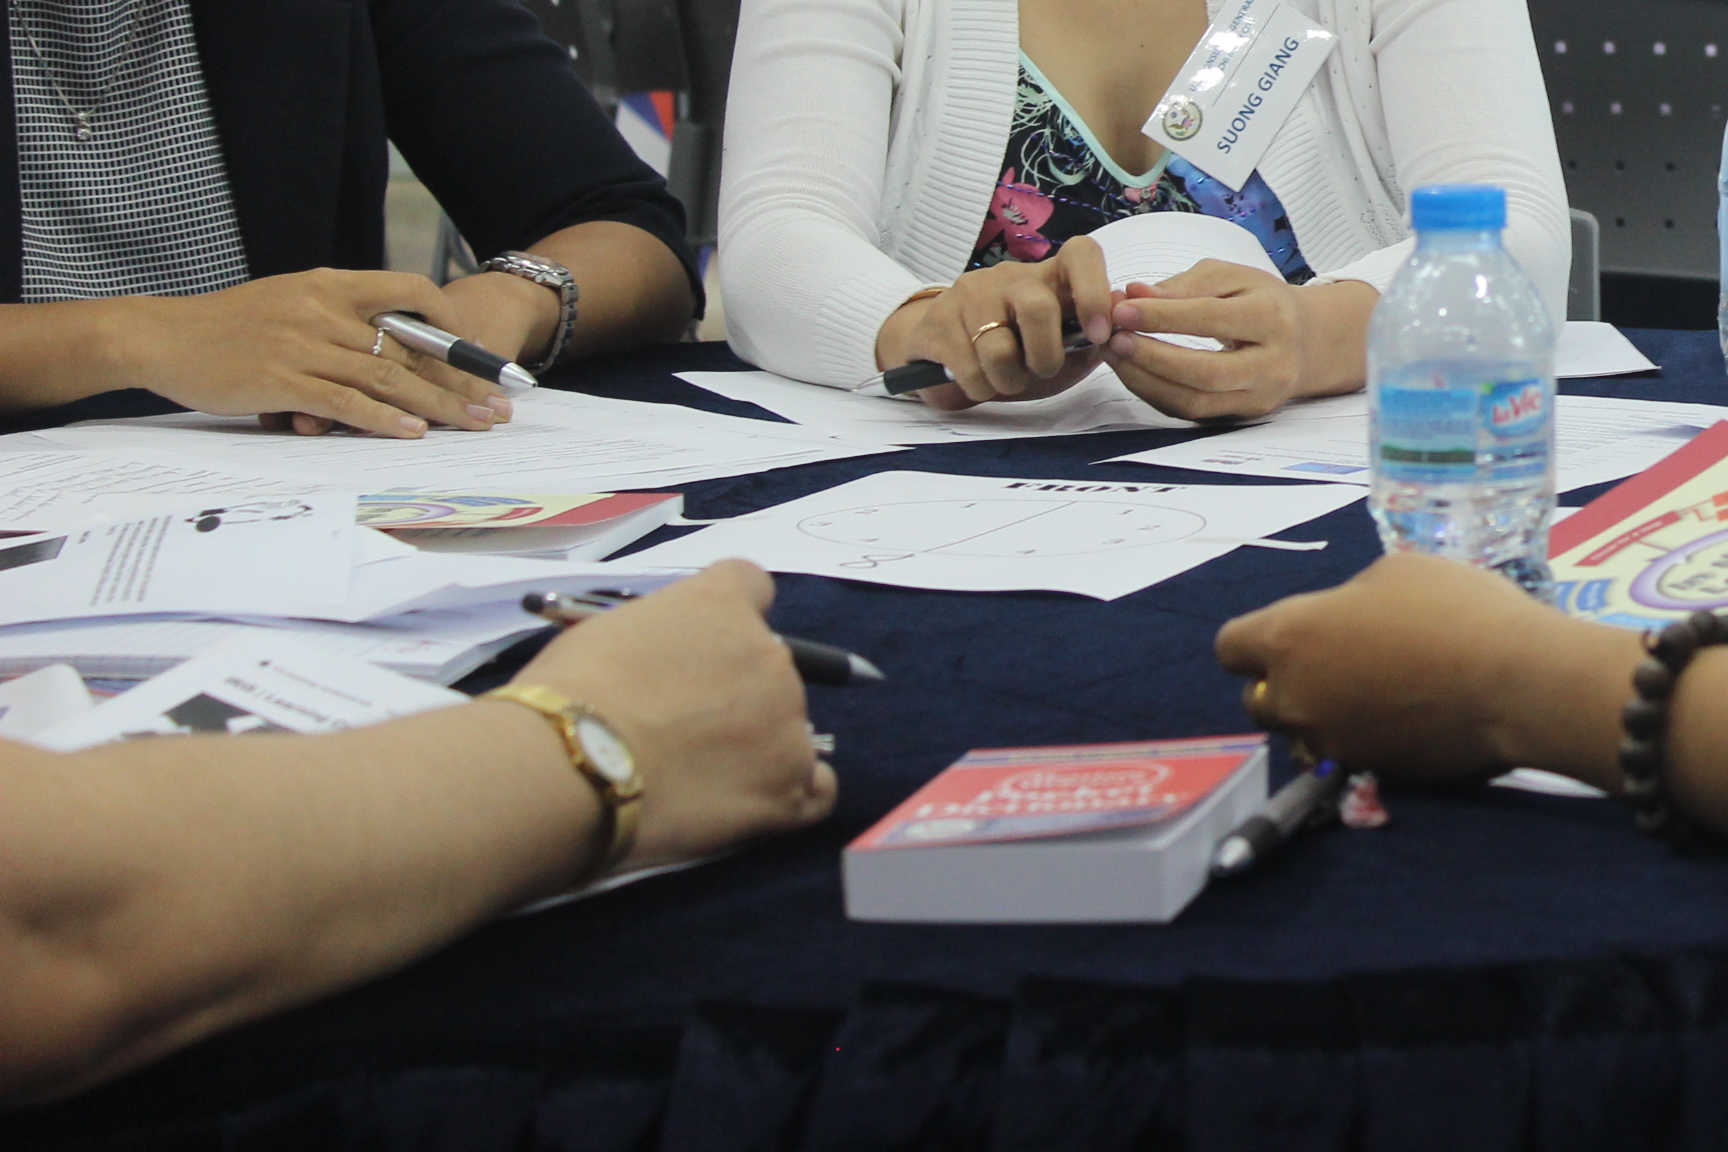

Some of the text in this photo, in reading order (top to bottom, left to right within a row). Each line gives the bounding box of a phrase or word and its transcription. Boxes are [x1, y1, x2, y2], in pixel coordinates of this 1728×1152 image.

[1216, 36, 1300, 154] SUONG GIANG
[1002, 481, 1189, 494] FRONT
[1668, 572, 1716, 591] In
